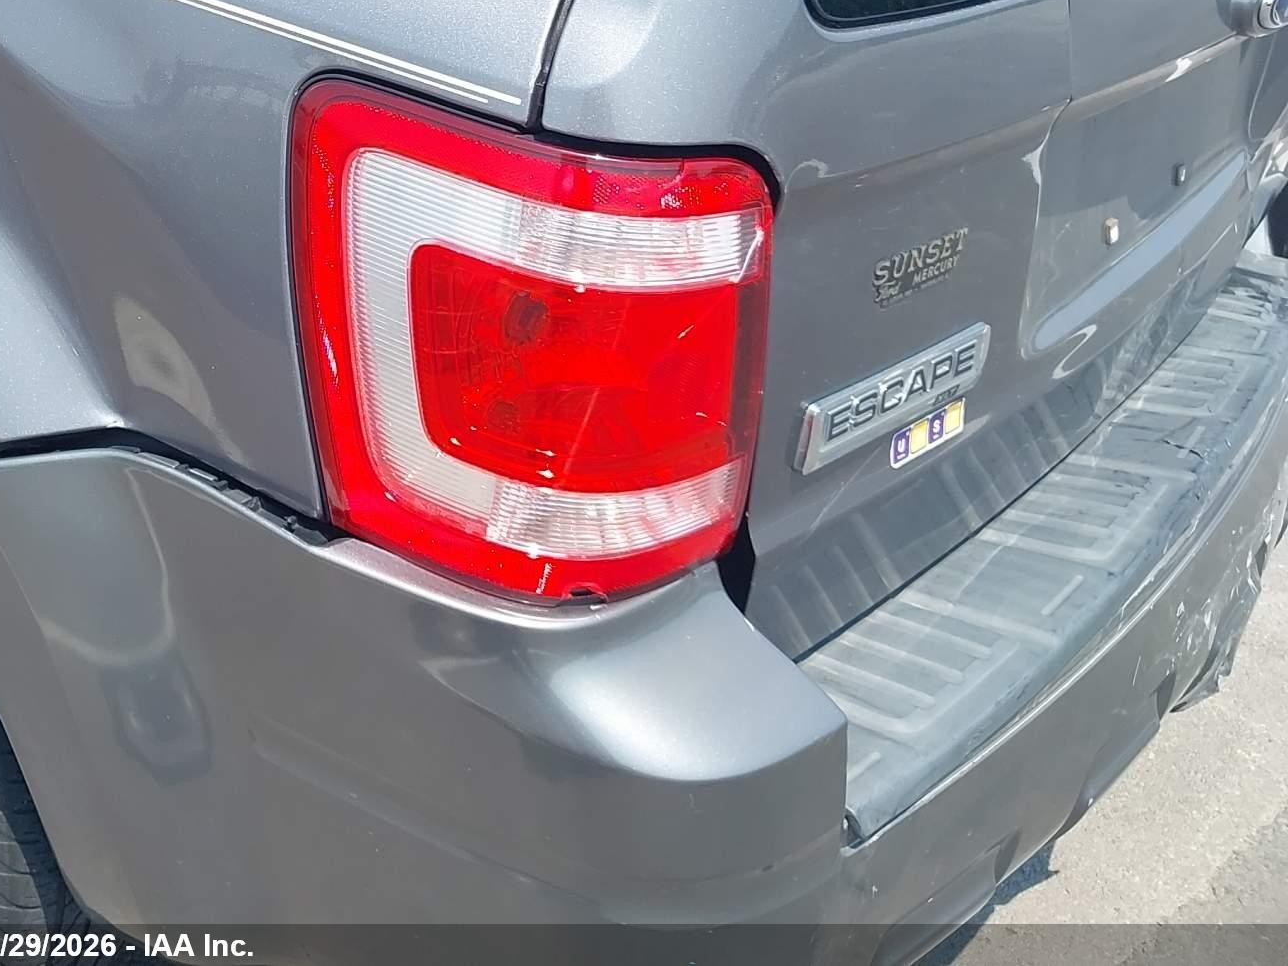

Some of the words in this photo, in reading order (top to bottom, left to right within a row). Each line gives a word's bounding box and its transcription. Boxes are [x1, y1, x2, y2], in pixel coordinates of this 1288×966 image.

[873, 227, 969, 286] SUNSET
[912, 254, 961, 286] MERCURY
[825, 338, 978, 442] ESCAPE
